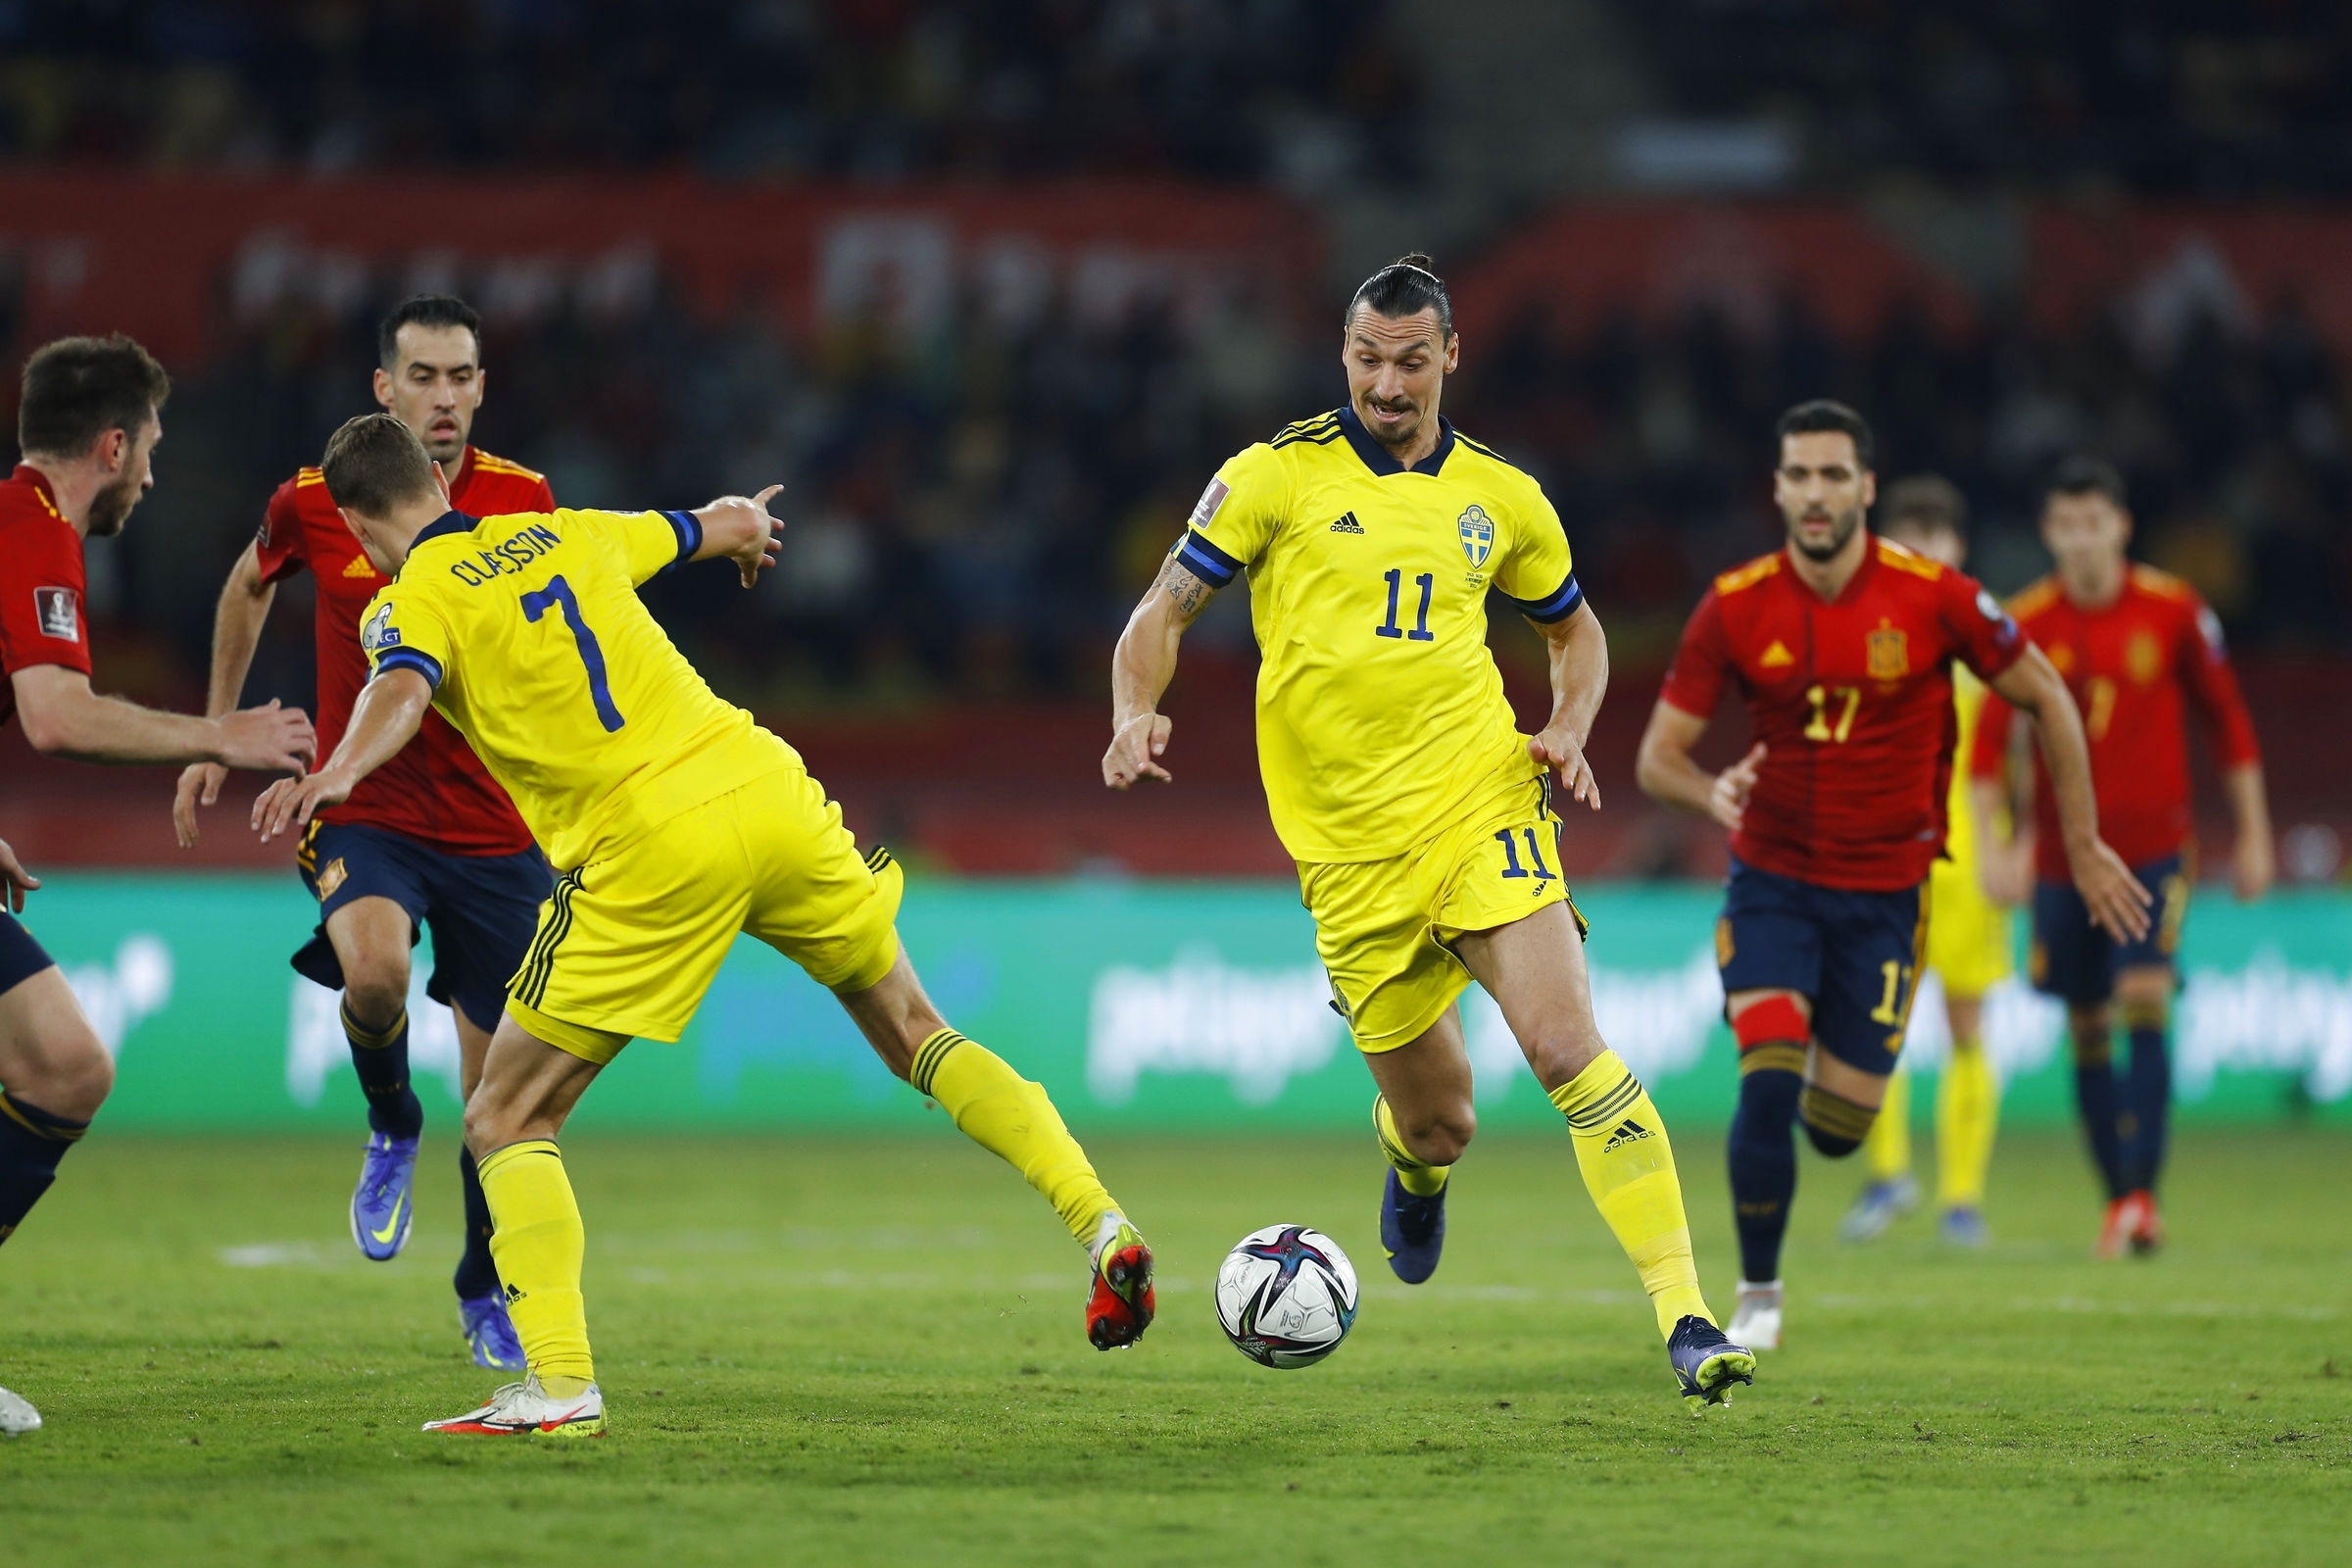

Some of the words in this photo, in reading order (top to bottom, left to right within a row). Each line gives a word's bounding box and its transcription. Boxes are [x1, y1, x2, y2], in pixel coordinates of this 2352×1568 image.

[1330, 524, 1365, 535] adidas
[1376, 568, 1434, 642] 11
[519, 574, 625, 733] 7
[1805, 685, 1861, 743] 17
[1494, 828, 1557, 879] 11
[1604, 1130, 1656, 1153] adidas
